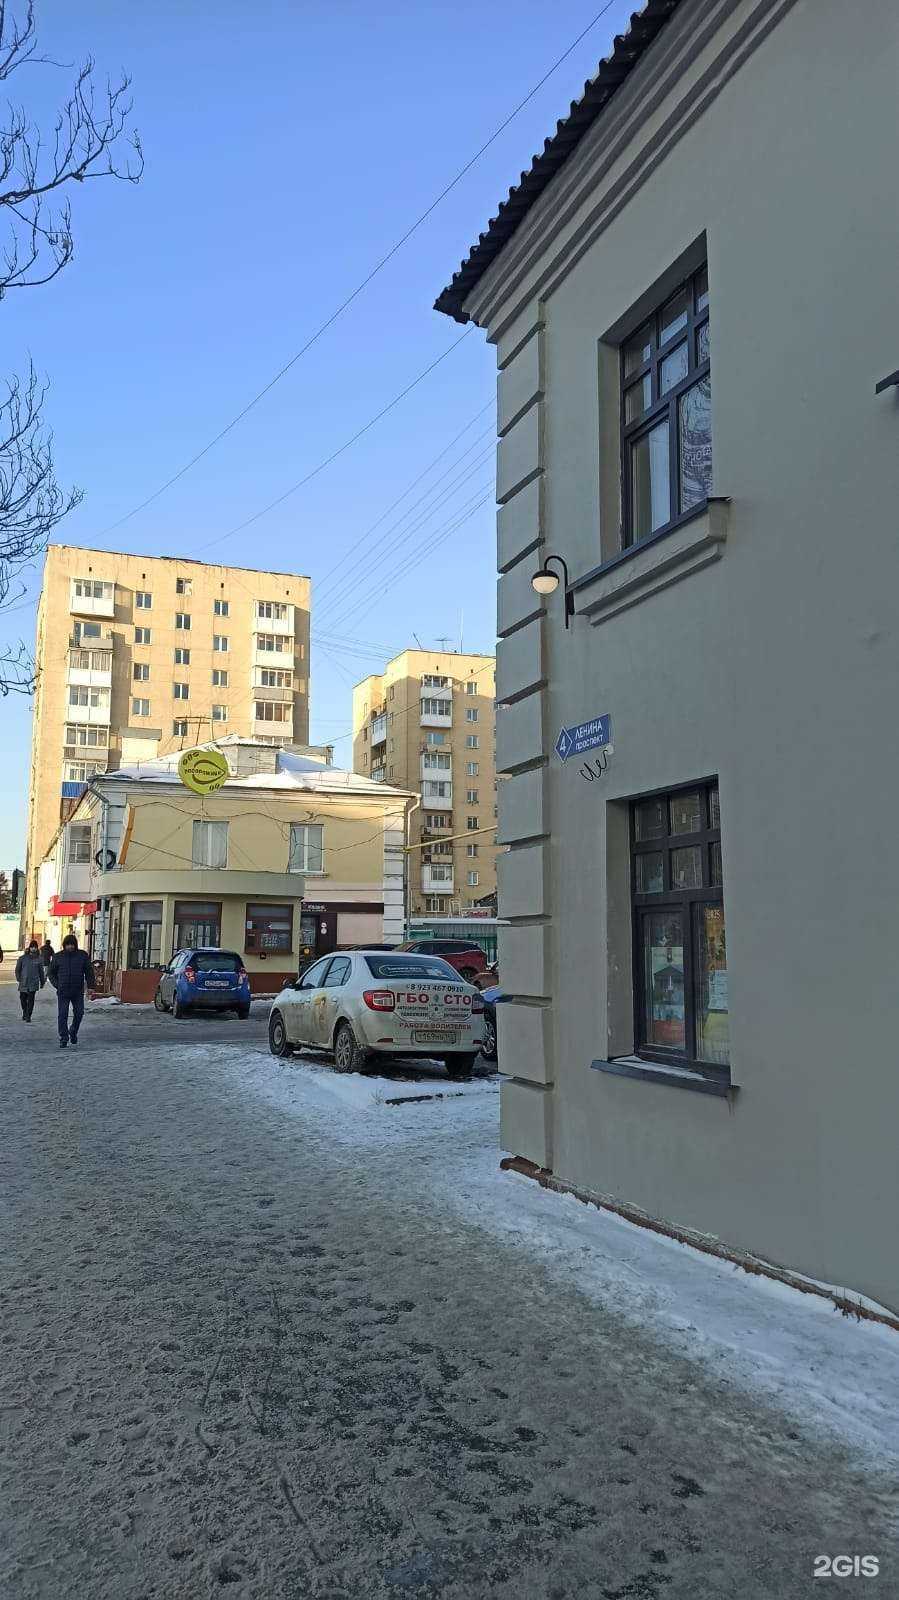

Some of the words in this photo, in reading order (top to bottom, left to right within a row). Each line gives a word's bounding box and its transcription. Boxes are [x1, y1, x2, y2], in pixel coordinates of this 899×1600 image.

[575, 720, 603, 741] ЛЕНИНА
[560, 735, 567, 753] 4
[575, 735, 603, 751] проспект
[397, 992, 430, 1004] ГБО
[443, 994, 472, 1006] СТО
